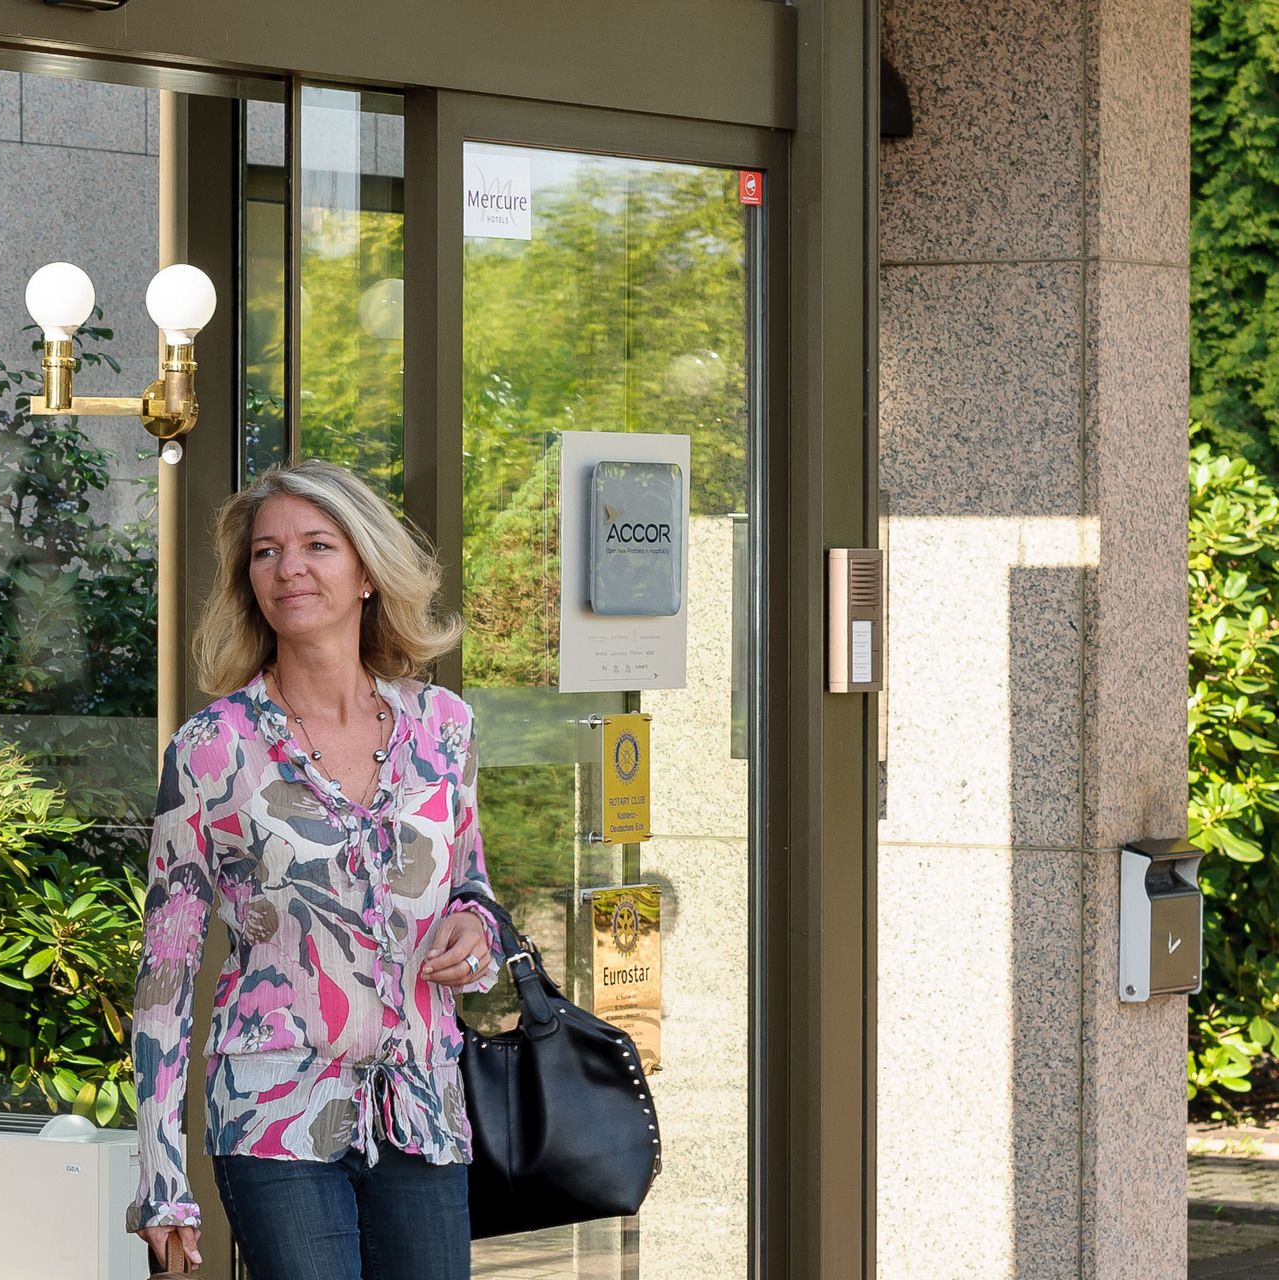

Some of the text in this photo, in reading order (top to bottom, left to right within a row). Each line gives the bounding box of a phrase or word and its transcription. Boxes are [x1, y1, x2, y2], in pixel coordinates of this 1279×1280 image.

[467, 189, 527, 211] Mercure
[487, 215, 509, 224] HOTELS
[606, 523, 671, 543] ACCOR
[609, 795, 645, 806] ROTARY CLUB
[603, 964, 650, 986] Eurostar
